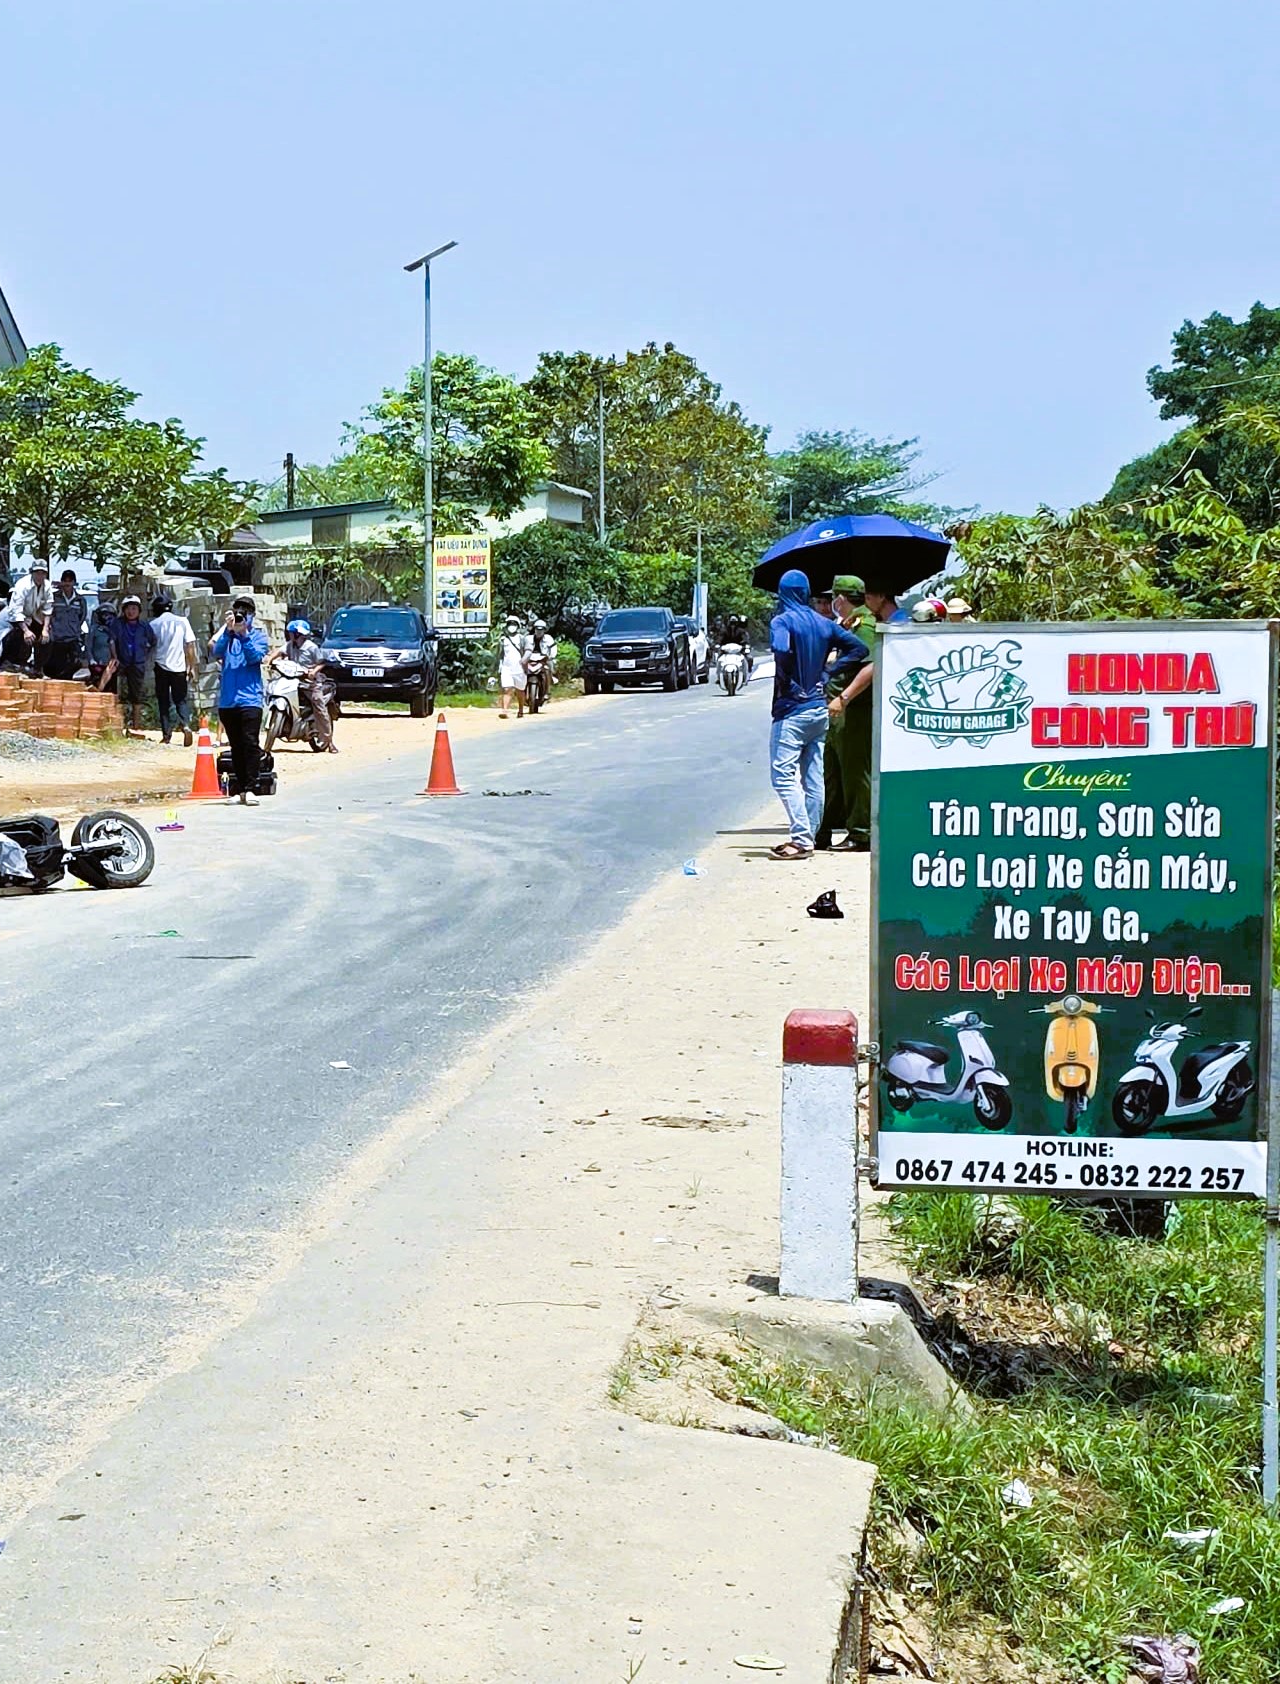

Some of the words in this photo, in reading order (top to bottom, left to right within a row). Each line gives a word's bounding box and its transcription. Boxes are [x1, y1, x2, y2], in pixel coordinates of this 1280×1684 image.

[1067, 652, 1221, 694] HONDA
[914, 713, 962, 730] CUSTOM
[963, 713, 1008, 730] GARAGE
[1031, 702, 1150, 748] CÔNG
[1023, 763, 1132, 796] Chuyên:
[928, 798, 981, 837] Tân
[990, 802, 1088, 840] Trang,
[1097, 802, 1154, 838] Sơn
[1165, 797, 1221, 838] Sửa
[911, 852, 966, 888] Các
[976, 853, 1037, 896] Loại
[1046, 853, 1083, 889] Xe
[1093, 846, 1151, 890] Gắn
[1160, 852, 1238, 893] Máy,
[993, 905, 1031, 940] Xe
[1039, 905, 1092, 944] Tay
[1102, 905, 1150, 945] Ga,
[894, 951, 950, 991] Các
[959, 955, 1021, 999] Loại
[1028, 956, 1068, 993] Xe
[1076, 954, 1144, 996] Máy
[1151, 955, 1252, 1002] Điện...
[1026, 1140, 1115, 1158] HOTLINE:
[895, 1159, 953, 1182] 0867
[961, 1160, 1006, 1183] 474
[1013, 1163, 1058, 1185] 245
[1079, 1164, 1140, 1188] 0832
[1147, 1165, 1193, 1189] 222
[1200, 1167, 1246, 1191] 257
